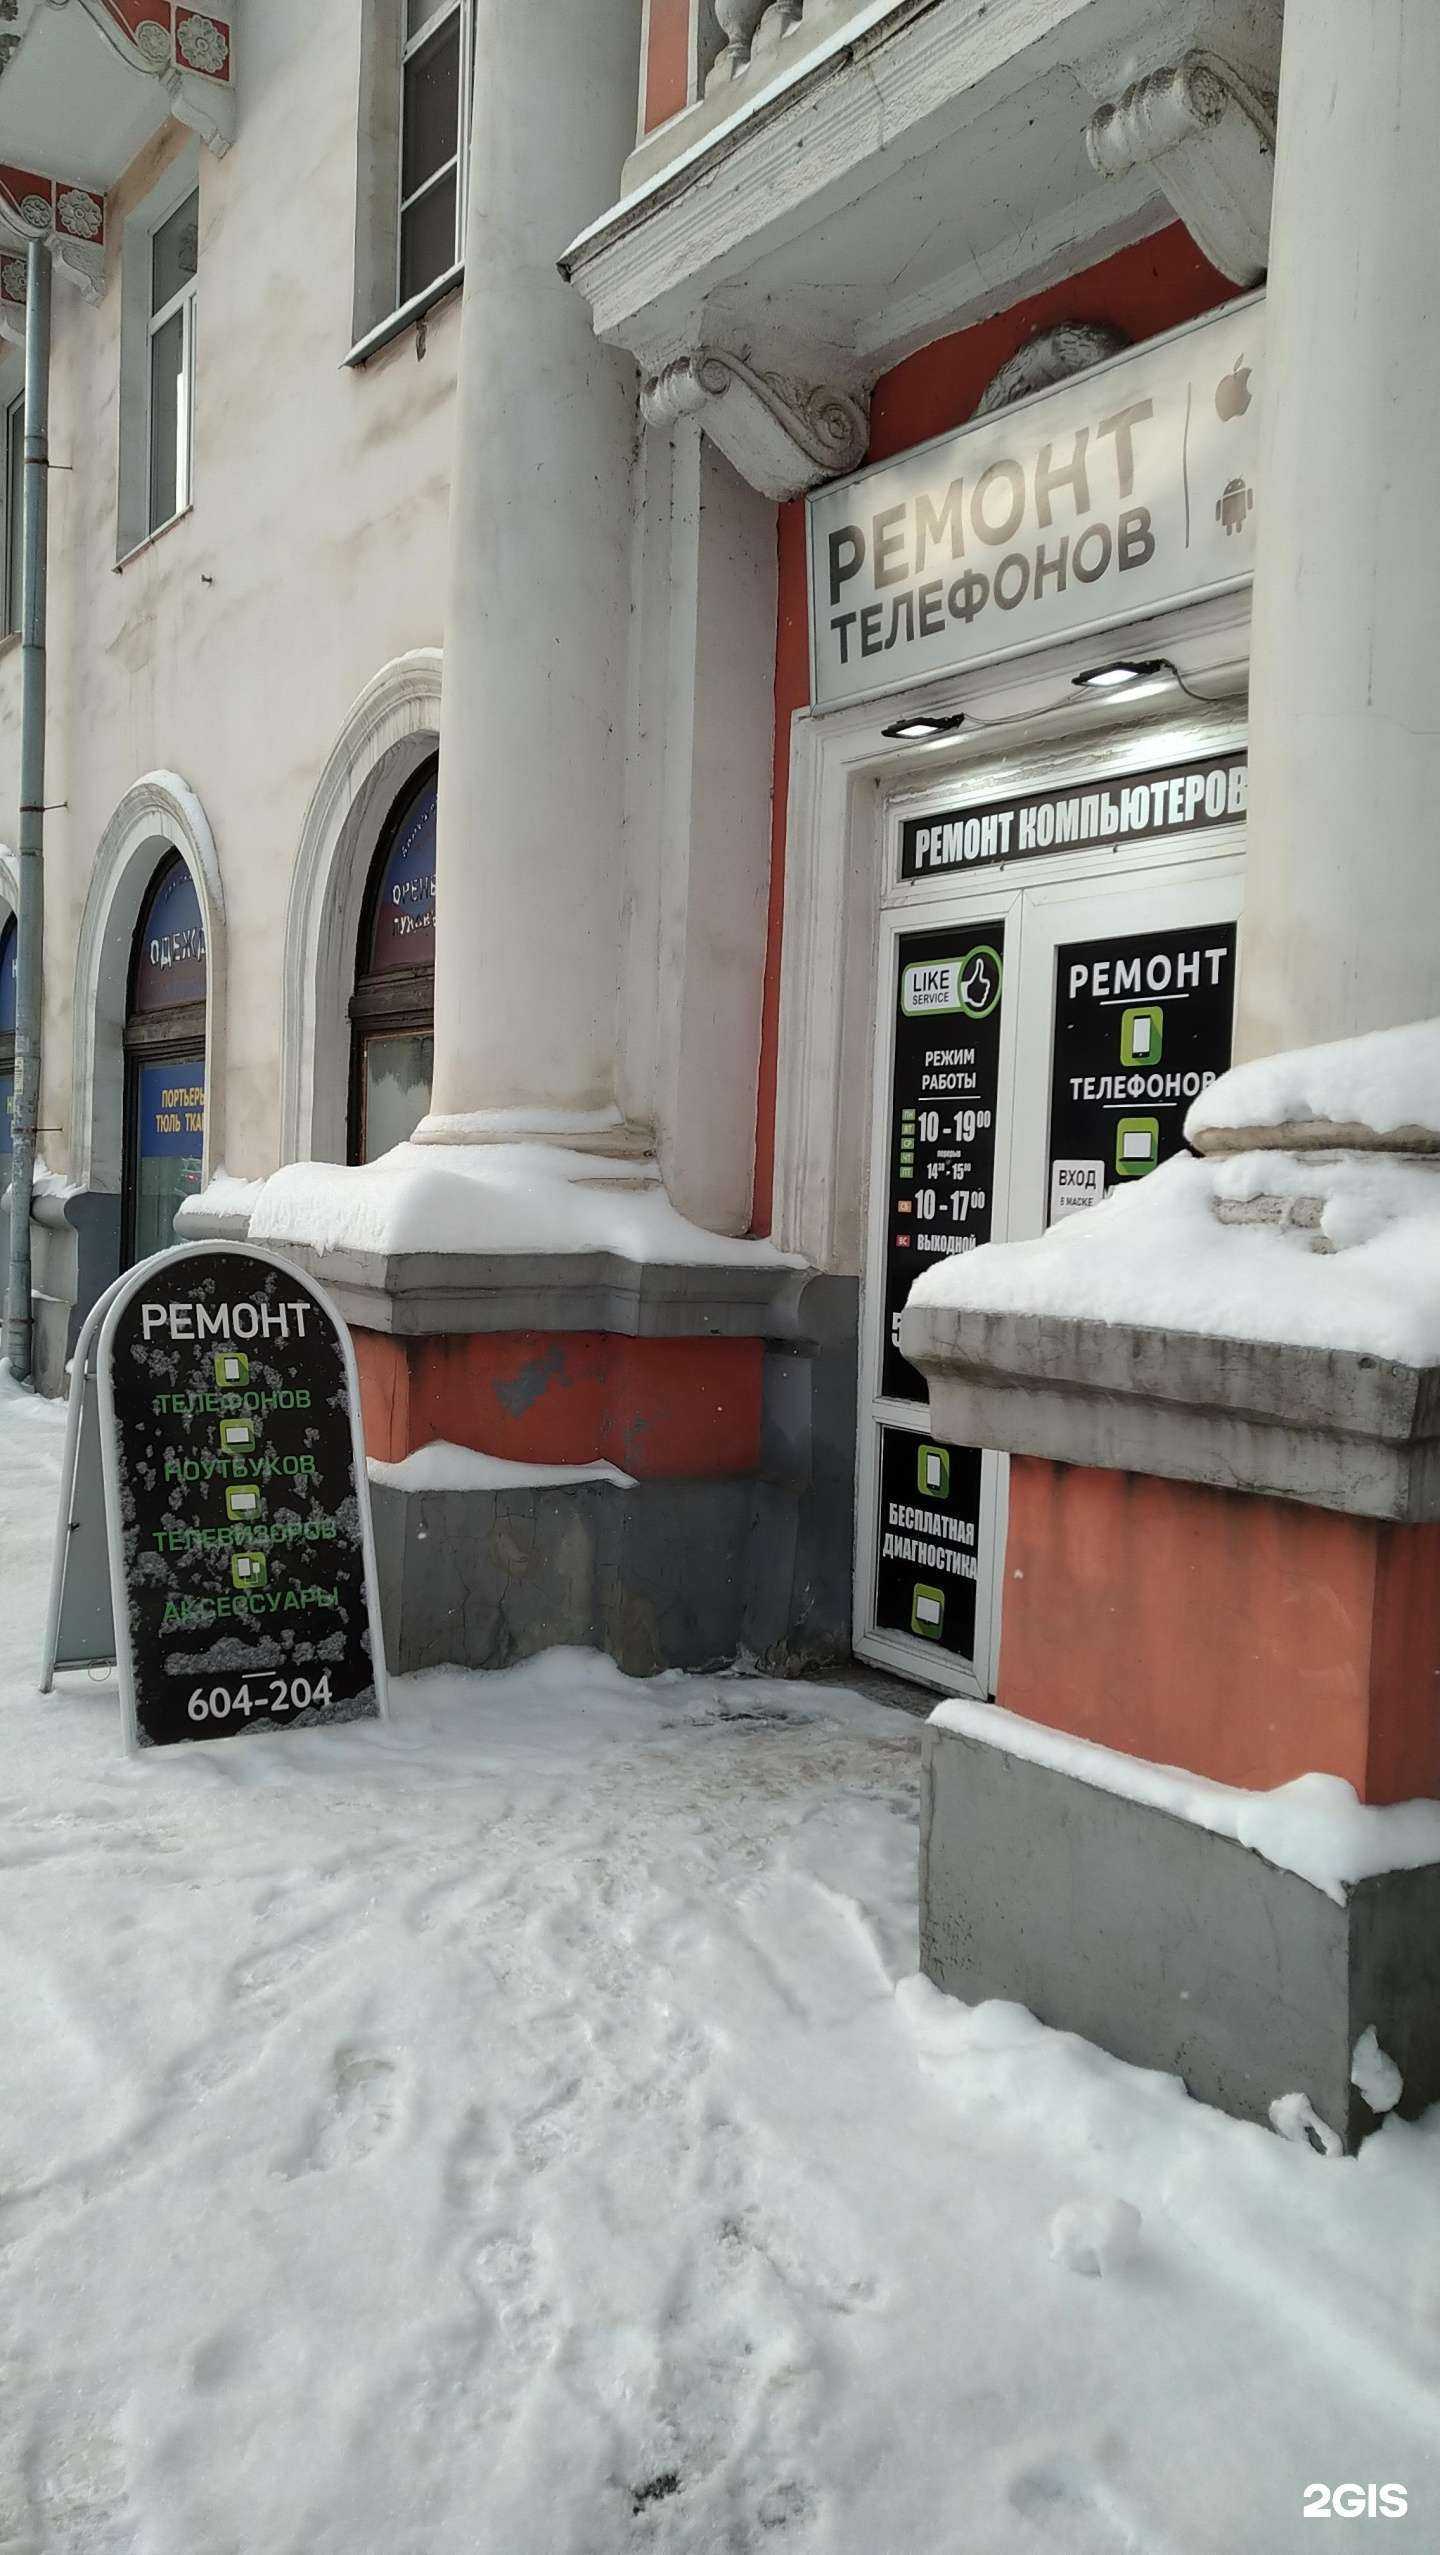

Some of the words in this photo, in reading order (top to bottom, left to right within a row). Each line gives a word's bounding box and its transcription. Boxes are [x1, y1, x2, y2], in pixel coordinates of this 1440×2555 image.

[828, 398, 1154, 606] РЕМОНТ
[830, 505, 1155, 665] ТЕЛЕФОНОВ
[914, 811, 1014, 869] РЕМОНТ
[1018, 765, 1248, 850] КОМПЬЮТЕРОВ
[913, 969, 950, 992] LIKE
[1069, 947, 1228, 999] РЕМОНТ
[912, 991, 950, 1005] SERVICE
[925, 1048, 975, 1067] РЕЖИМ
[922, 1074, 977, 1091] РАБОТЫ
[155, 1114, 181, 1133] ТЮЛЬ
[918, 1110, 939, 1142] 10
[1059, 1170, 1096, 1190] ВХОД
[914, 1189, 936, 1220] 10
[917, 1234, 977, 1256] ВЫХОДНОЙ
[141, 1302, 311, 1341] РЕМОНТ
[155, 1389, 312, 1415] ТЕЛЕФОНОВ
[164, 1455, 316, 1482] НОУТБУКОВ
[152, 1519, 337, 1552] ТЕЛЕВИЗОРОВ
[889, 1502, 975, 1547] БЕСПЛАТНАЯ
[882, 1532, 977, 1580] ДИАГНОСТИКА
[163, 1586, 339, 1622] АКСЕССУАРЫ
[187, 1674, 333, 1722] 604-204
